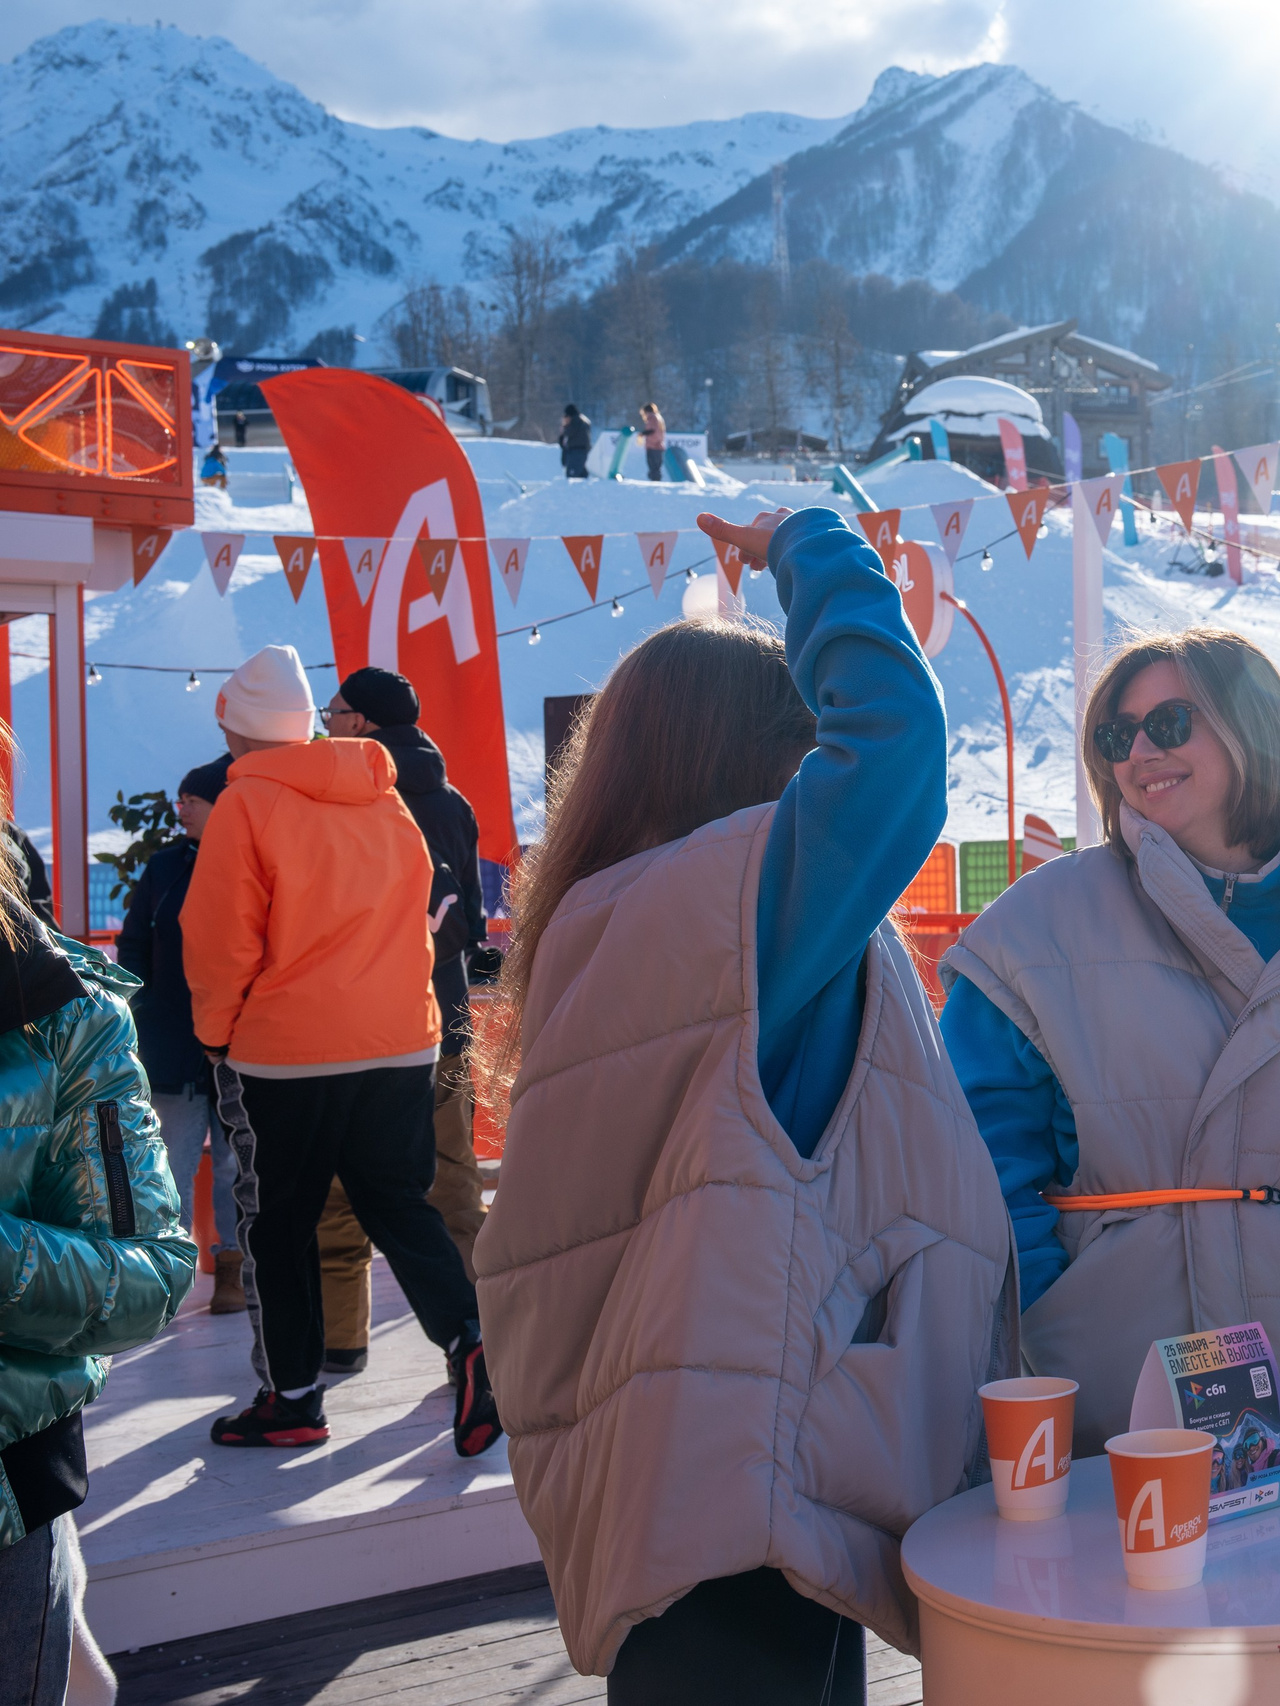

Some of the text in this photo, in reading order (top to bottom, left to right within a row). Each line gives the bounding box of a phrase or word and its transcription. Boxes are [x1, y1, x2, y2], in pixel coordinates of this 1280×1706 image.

[1254, 457, 1269, 485] A
[1176, 472, 1191, 502] A
[1021, 500, 1036, 527] A
[1096, 488, 1111, 515] A
[877, 521, 892, 548] A
[944, 512, 960, 536] A
[137, 535, 159, 557] A
[215, 544, 231, 568] A
[288, 547, 304, 572] A
[581, 545, 596, 572] A
[649, 542, 664, 567] A
[357, 549, 372, 574] A
[368, 477, 480, 673] A
[431, 549, 445, 575] A
[504, 548, 519, 575] A
[1164, 1344, 1177, 1357] 25
[1176, 1338, 1209, 1355] ЯНВАРЯ
[1216, 1335, 1223, 1347] 2
[1223, 1328, 1262, 1345] ФЕВРАЛЯ
[1169, 1342, 1268, 1375] ВМЕСТЕ НА ВЫСОТЕ
[1206, 1384, 1226, 1397] сбп
[1015, 1417, 1054, 1487] A
[1127, 1478, 1166, 1550] A
[1209, 1497, 1246, 1513] OSAFEST
[1170, 1514, 1202, 1538] APEROL
[1177, 1525, 1198, 1543] SPRITZ
